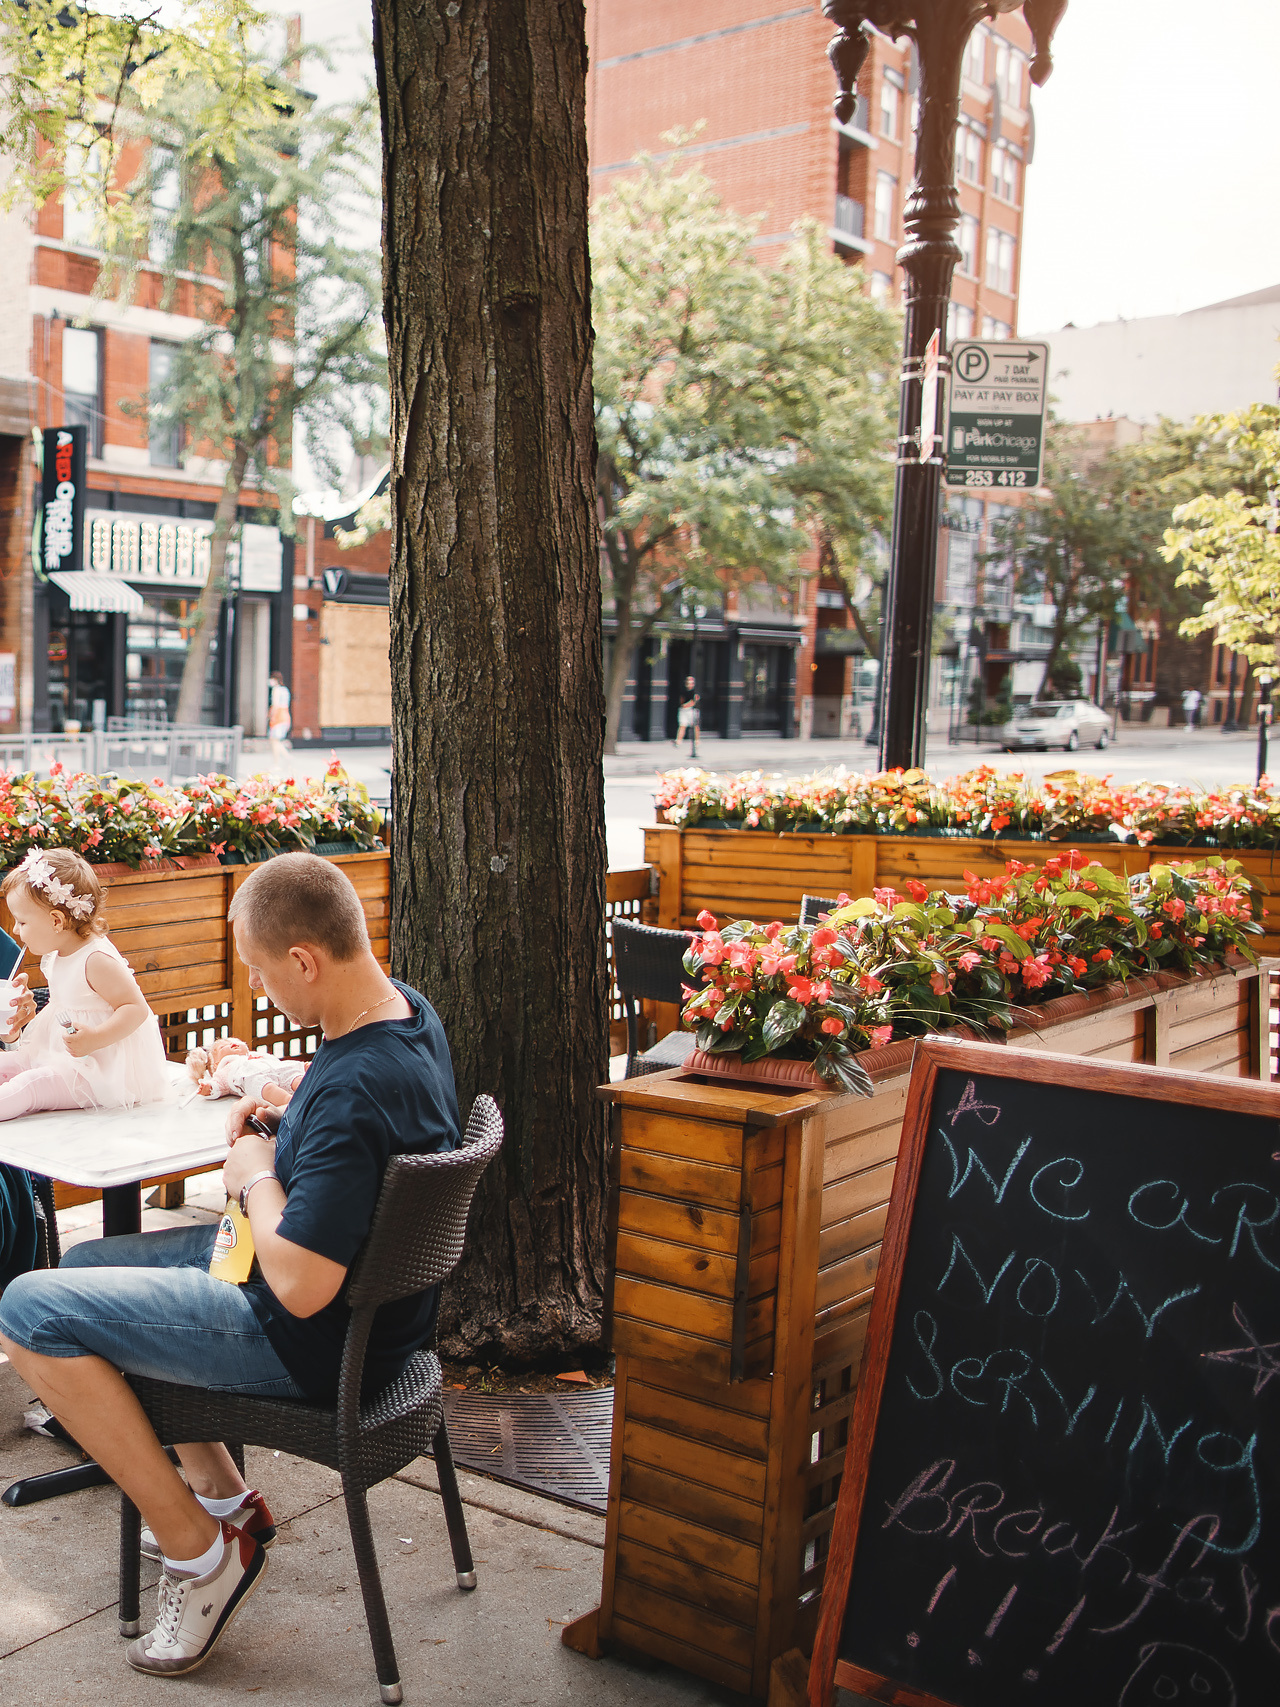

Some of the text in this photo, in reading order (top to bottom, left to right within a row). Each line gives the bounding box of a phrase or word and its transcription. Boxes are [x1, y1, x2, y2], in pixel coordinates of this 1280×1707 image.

[965, 353, 982, 375] P
[1004, 365, 1031, 375] 7 DAY
[1011, 376, 1040, 385] PARKING
[954, 390, 1040, 403] PAY AT PAY BOX
[976, 418, 992, 426] SIGN
[993, 419, 1003, 427] UP
[966, 455, 1019, 465] FOR MOBILE PAY
[965, 470, 993, 487] 253
[997, 471, 1026, 487] 412
[324, 569, 342, 595] V
[935, 1231, 1202, 1339] NOW
